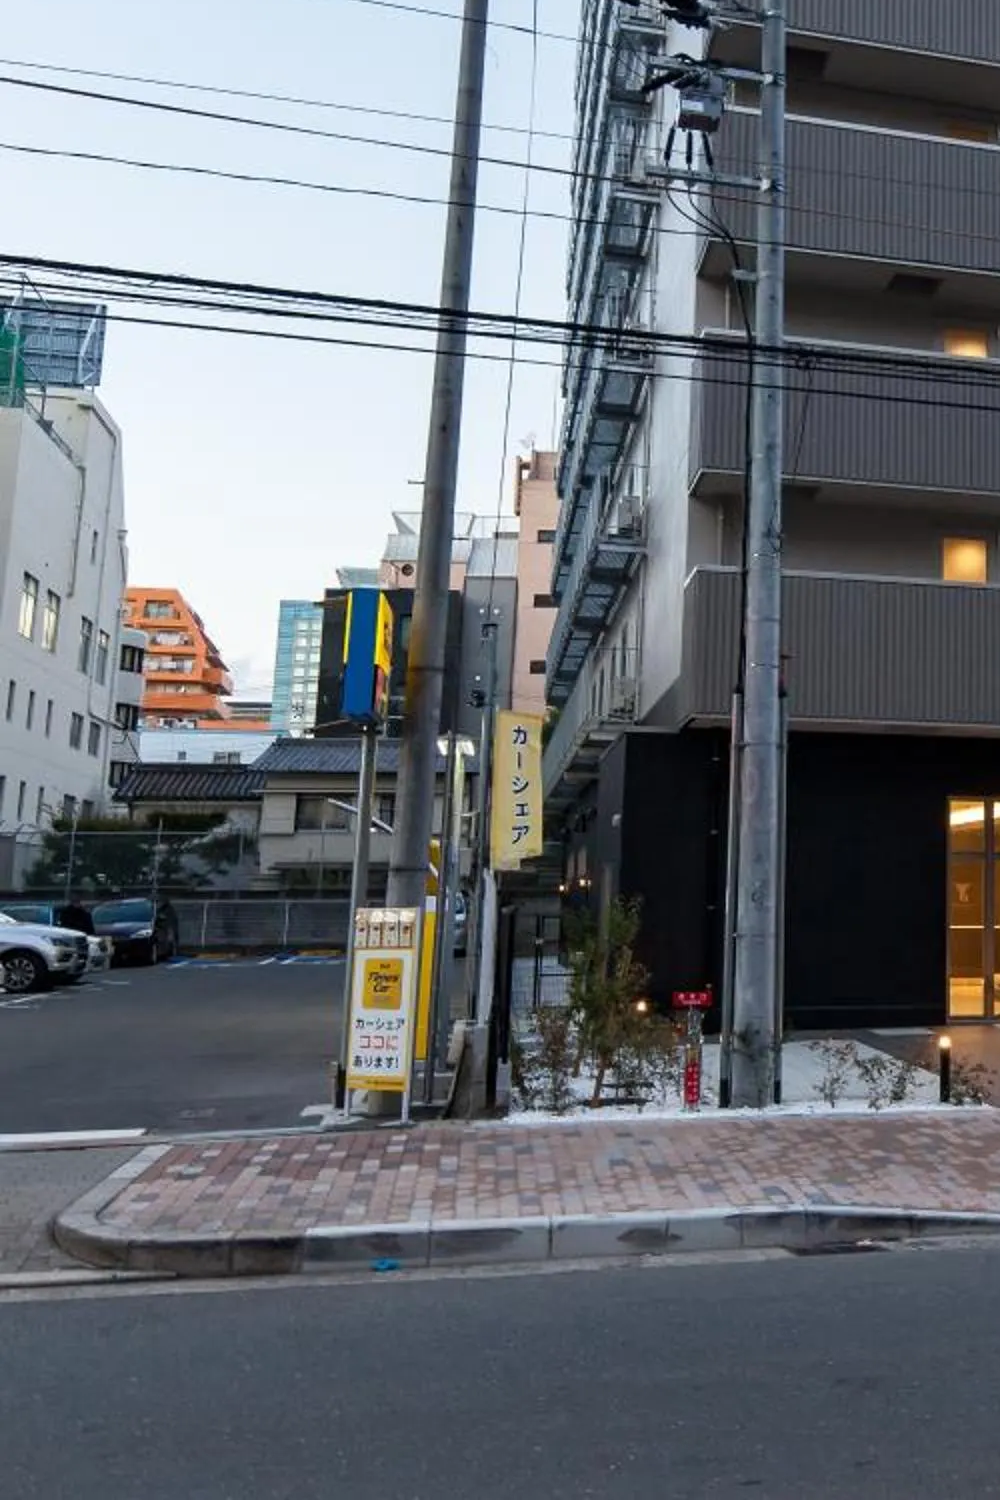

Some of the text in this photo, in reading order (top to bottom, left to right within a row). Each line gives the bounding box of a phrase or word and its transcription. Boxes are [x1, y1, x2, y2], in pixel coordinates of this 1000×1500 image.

[511, 725, 530, 845] カーシェア
[355, 1017, 405, 1031] カーシェア
[359, 1035, 399, 1050] ココに
